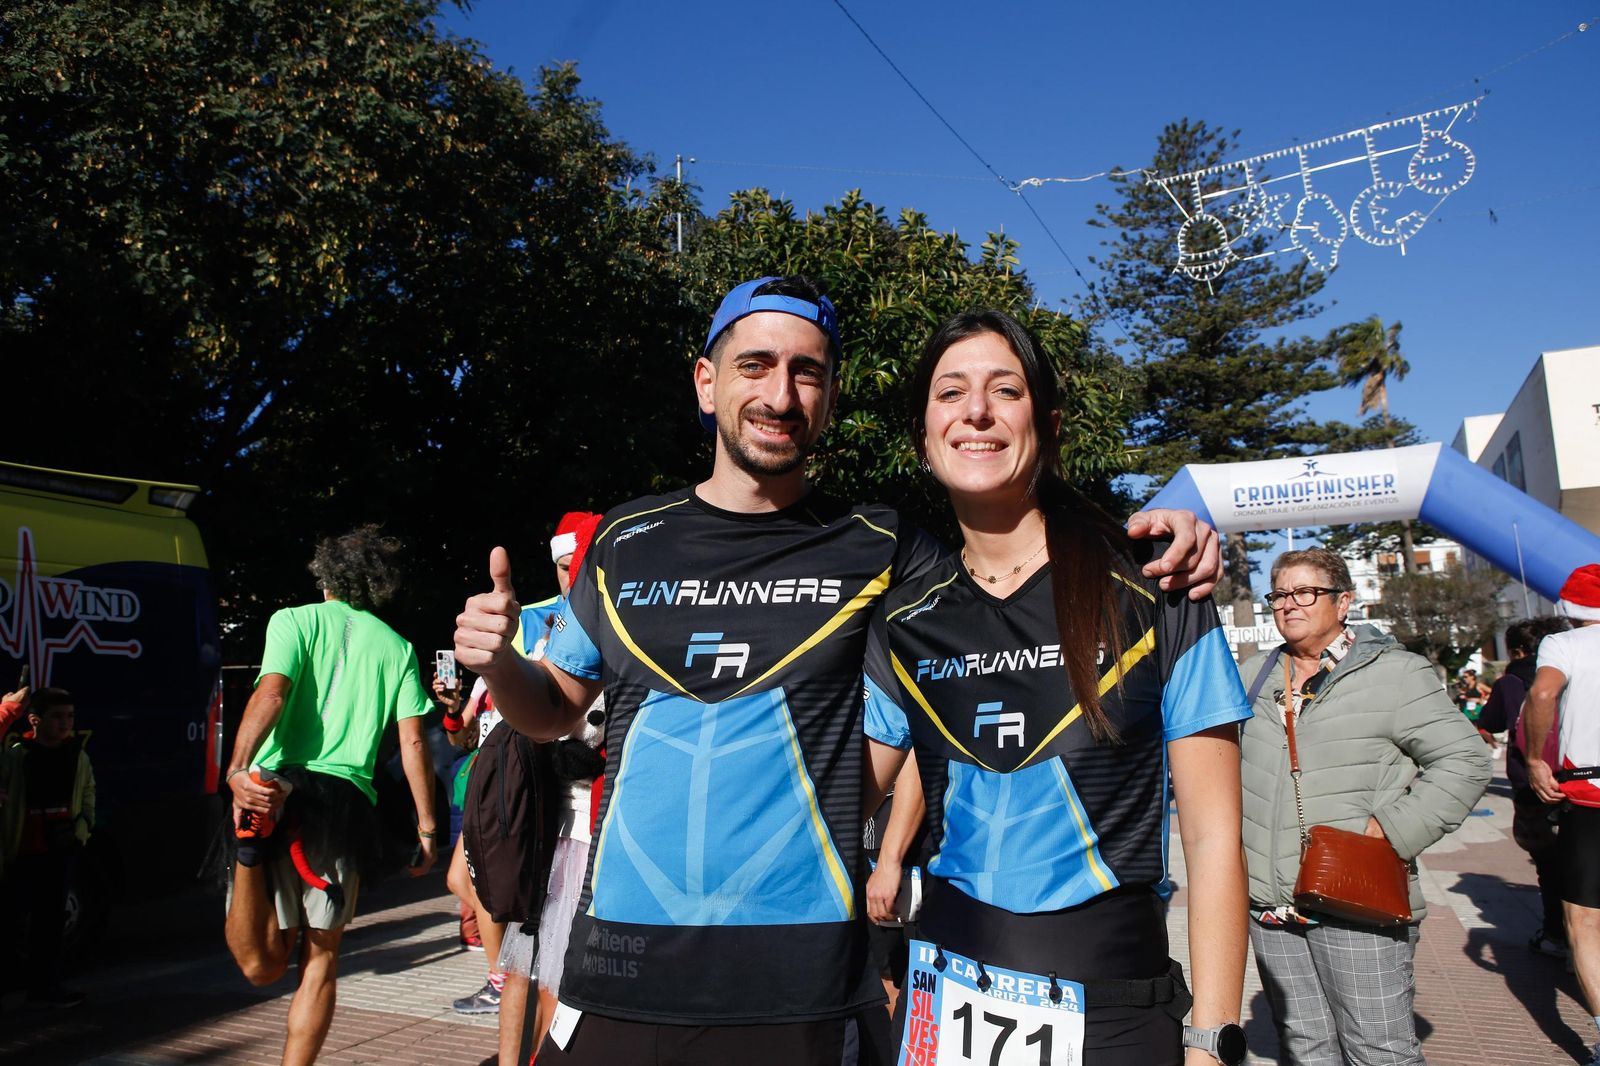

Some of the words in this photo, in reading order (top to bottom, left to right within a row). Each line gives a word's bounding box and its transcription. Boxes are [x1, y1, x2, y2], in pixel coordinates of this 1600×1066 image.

[1233, 472, 1396, 508] CRONOFINISHER
[39, 580, 137, 618] WIND
[616, 578, 842, 608] FUNRUNNERS
[916, 641, 1106, 683] FUNRUNNES
[912, 969, 937, 995] SAN
[978, 987, 1027, 1004] ARIFA
[910, 989, 935, 1022] SIL
[908, 1016, 940, 1052] VES
[952, 1001, 1053, 1066] 171
